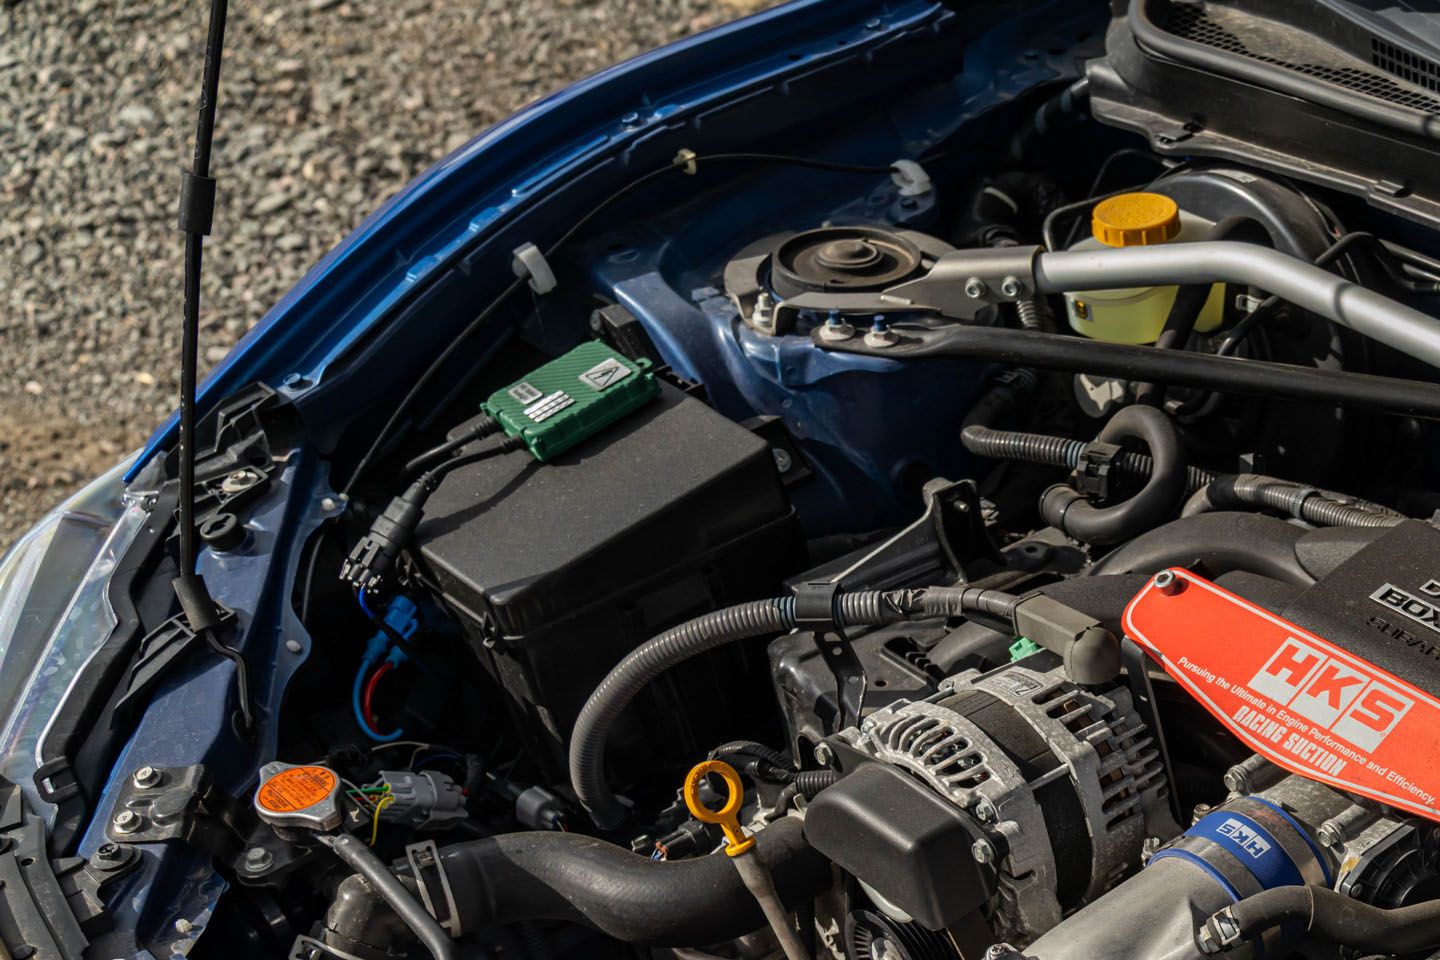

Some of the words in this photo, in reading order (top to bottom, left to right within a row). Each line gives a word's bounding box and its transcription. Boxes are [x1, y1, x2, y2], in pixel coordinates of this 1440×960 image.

[1177, 656, 1217, 683] Pursuing
[1215, 676, 1231, 690] the
[1230, 684, 1267, 709] Ultimate
[1266, 703, 1277, 715] in
[1276, 709, 1309, 733] Engine
[1307, 726, 1367, 765] Performance
[1366, 761, 1388, 776] and
[1386, 770, 1436, 805] Efficiency.
[1258, 639, 1409, 743] HKS
[1232, 705, 1288, 744] RACING
[1282, 733, 1347, 777] SUCTION
[1217, 821, 1267, 858] HKS
